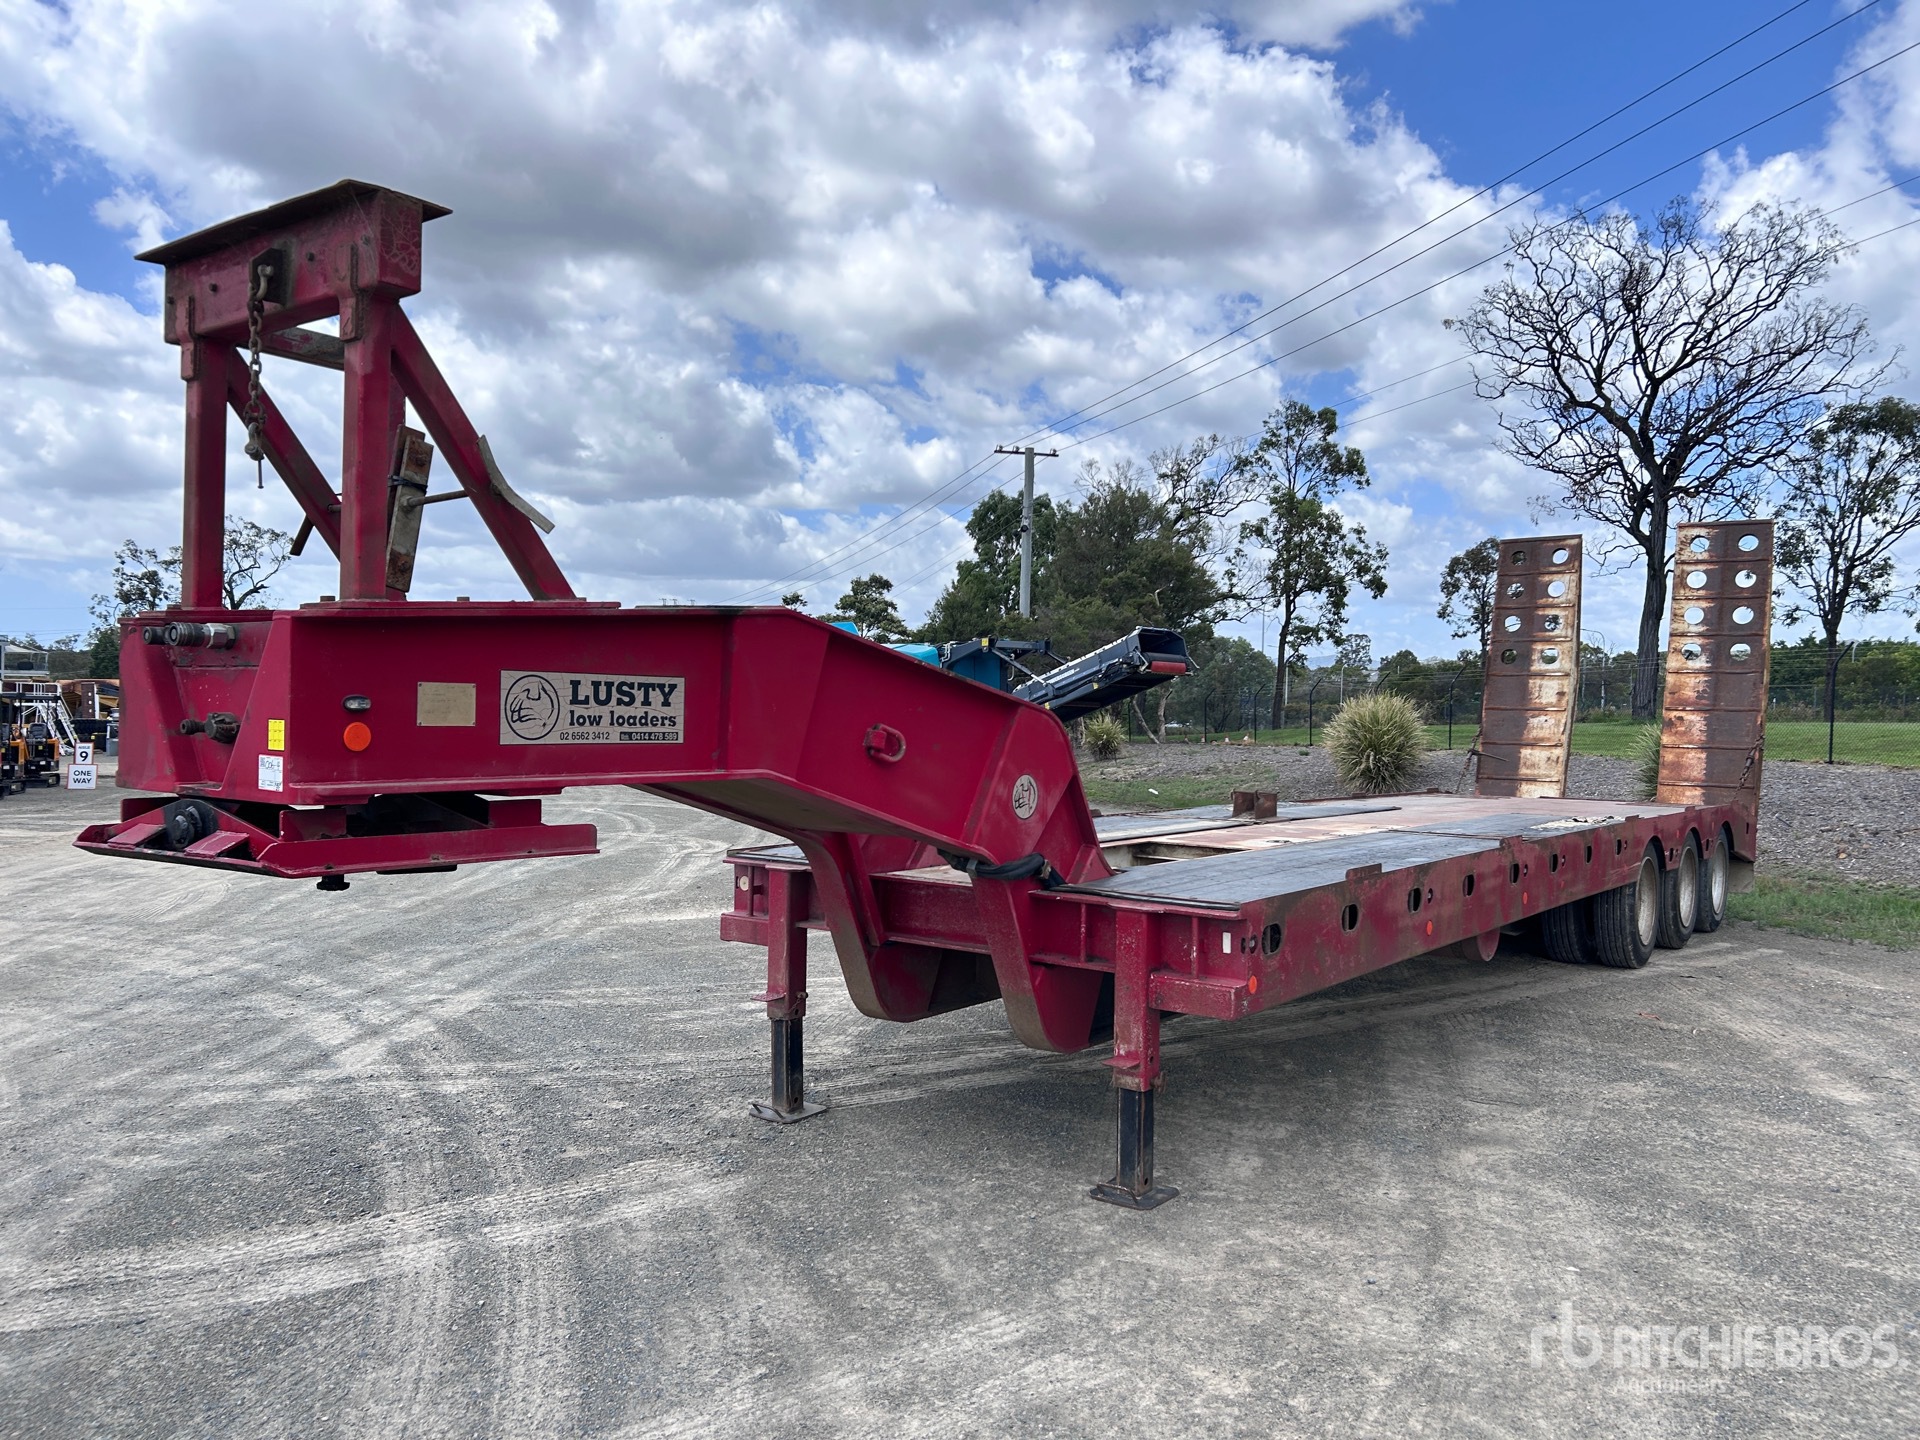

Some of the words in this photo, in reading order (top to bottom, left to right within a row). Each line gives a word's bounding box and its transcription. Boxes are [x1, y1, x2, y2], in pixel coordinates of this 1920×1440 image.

[569, 680, 678, 707] LUSTY
[569, 710, 603, 727] low
[609, 710, 677, 728] loaders
[559, 732, 569, 740] 02
[571, 732, 590, 741] 6562
[591, 732, 610, 741] 3412
[631, 732, 649, 740] 0414
[80, 751, 89, 762] 9
